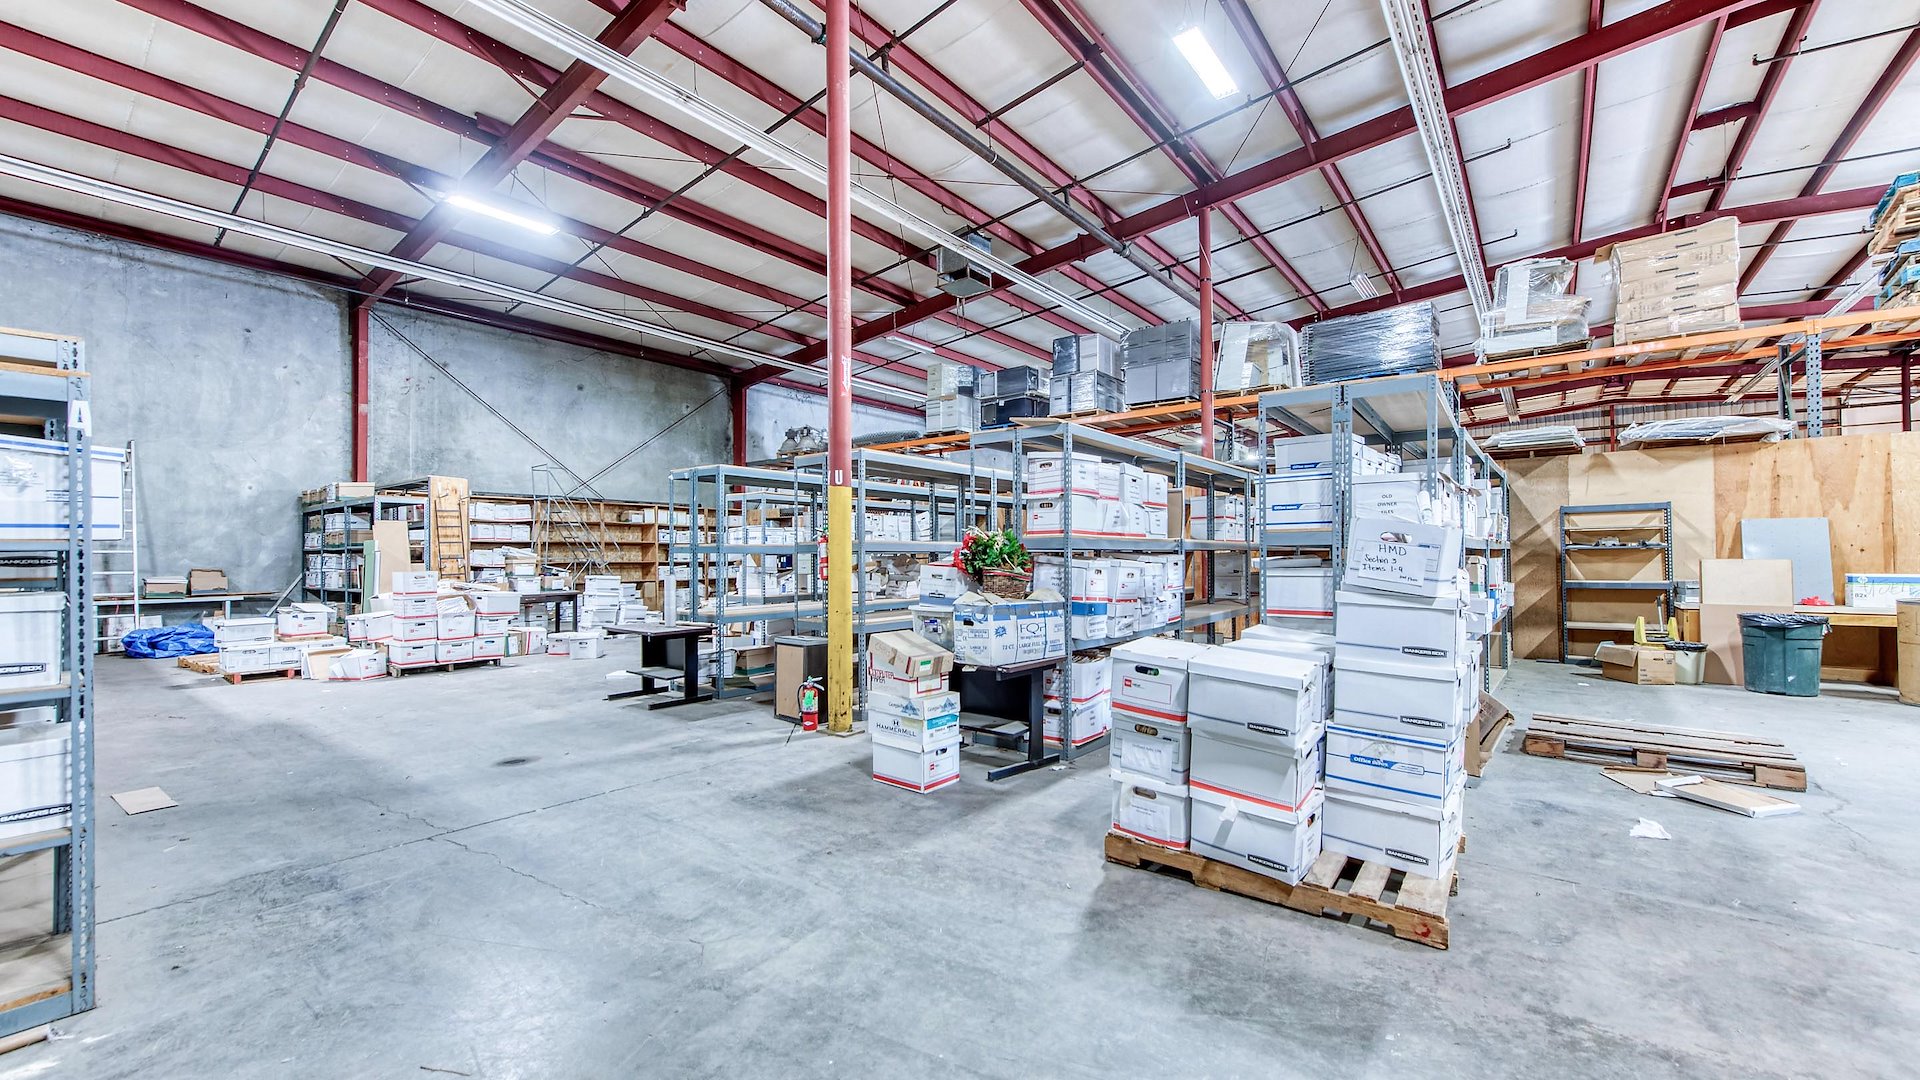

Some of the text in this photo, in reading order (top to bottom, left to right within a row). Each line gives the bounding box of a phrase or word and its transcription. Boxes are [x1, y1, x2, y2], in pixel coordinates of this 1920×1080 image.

[834, 469, 843, 485] U
[1378, 544, 1407, 556] HMD
[1364, 553, 1389, 564] Section
[1362, 563, 1386, 572] Items
[868, 667, 894, 680] COMPUTER
[1402, 717, 1430, 726] BANKERS
[876, 722, 917, 737] HAMMERMILL
[1249, 724, 1274, 733] BANKERS
[0, 805, 71, 822] BANKERS BOX
[1249, 855, 1286, 871] BANKERS BOX
[1387, 850, 1427, 864] BANKERS BOX
